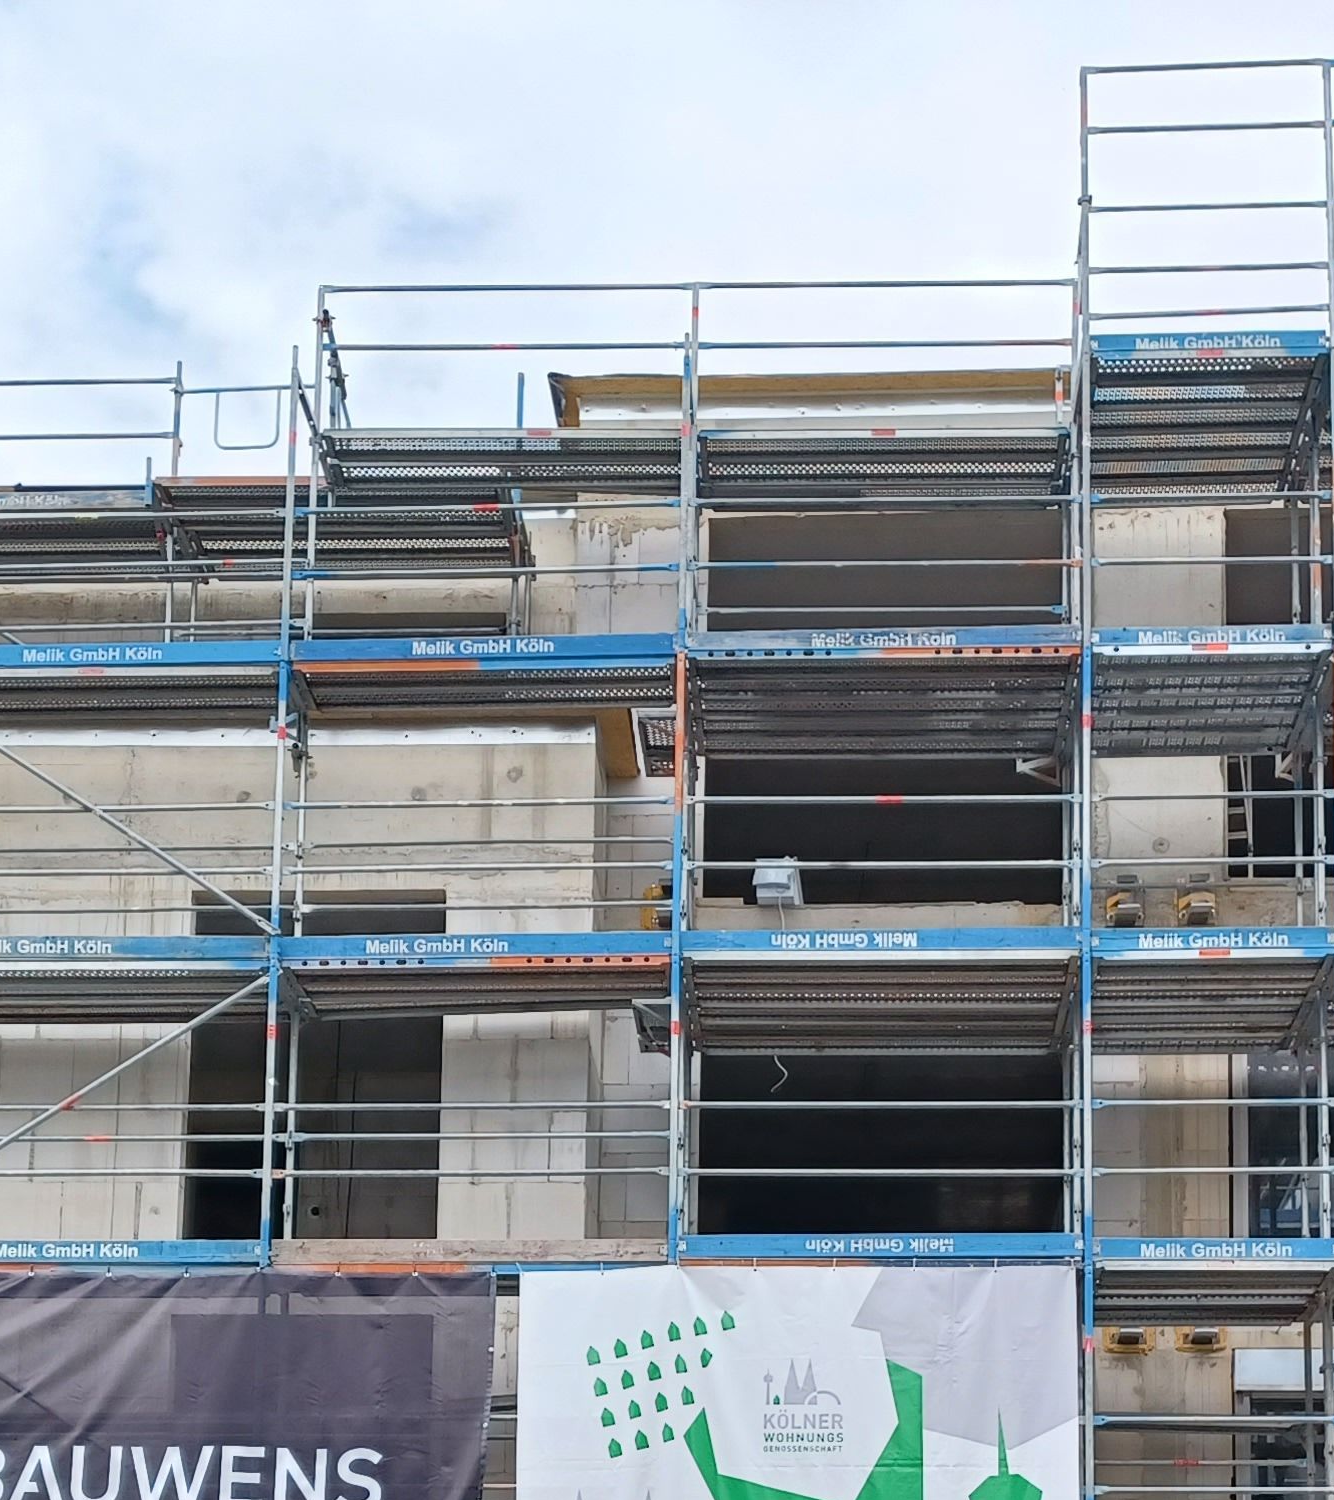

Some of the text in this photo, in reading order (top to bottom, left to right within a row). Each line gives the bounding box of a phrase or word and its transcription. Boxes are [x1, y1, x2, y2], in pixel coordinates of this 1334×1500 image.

[1135, 334, 1281, 350] Melik GmbH Köln
[1138, 628, 1285, 644] Melik GmbH Köln
[22, 646, 162, 662] Melik GmbH Köln
[412, 638, 554, 655] Melik GmbH Köln
[17, 938, 68, 954] GmbH
[74, 938, 112, 954] Köln
[366, 938, 509, 954] Melik GmbH Köln
[771, 931, 917, 948] Melik GmbH Köln
[1138, 932, 1288, 948] Melik GmbH Köln
[42, 1243, 94, 1258] GmbH
[99, 1243, 138, 1258] Köln
[805, 1237, 954, 1253] Melik GmbH Köln
[1141, 1241, 1292, 1258] Melik GmbH Köln
[763, 1409, 843, 1429] KÖLNER
[763, 1432, 844, 1442] WOHNUNGS
